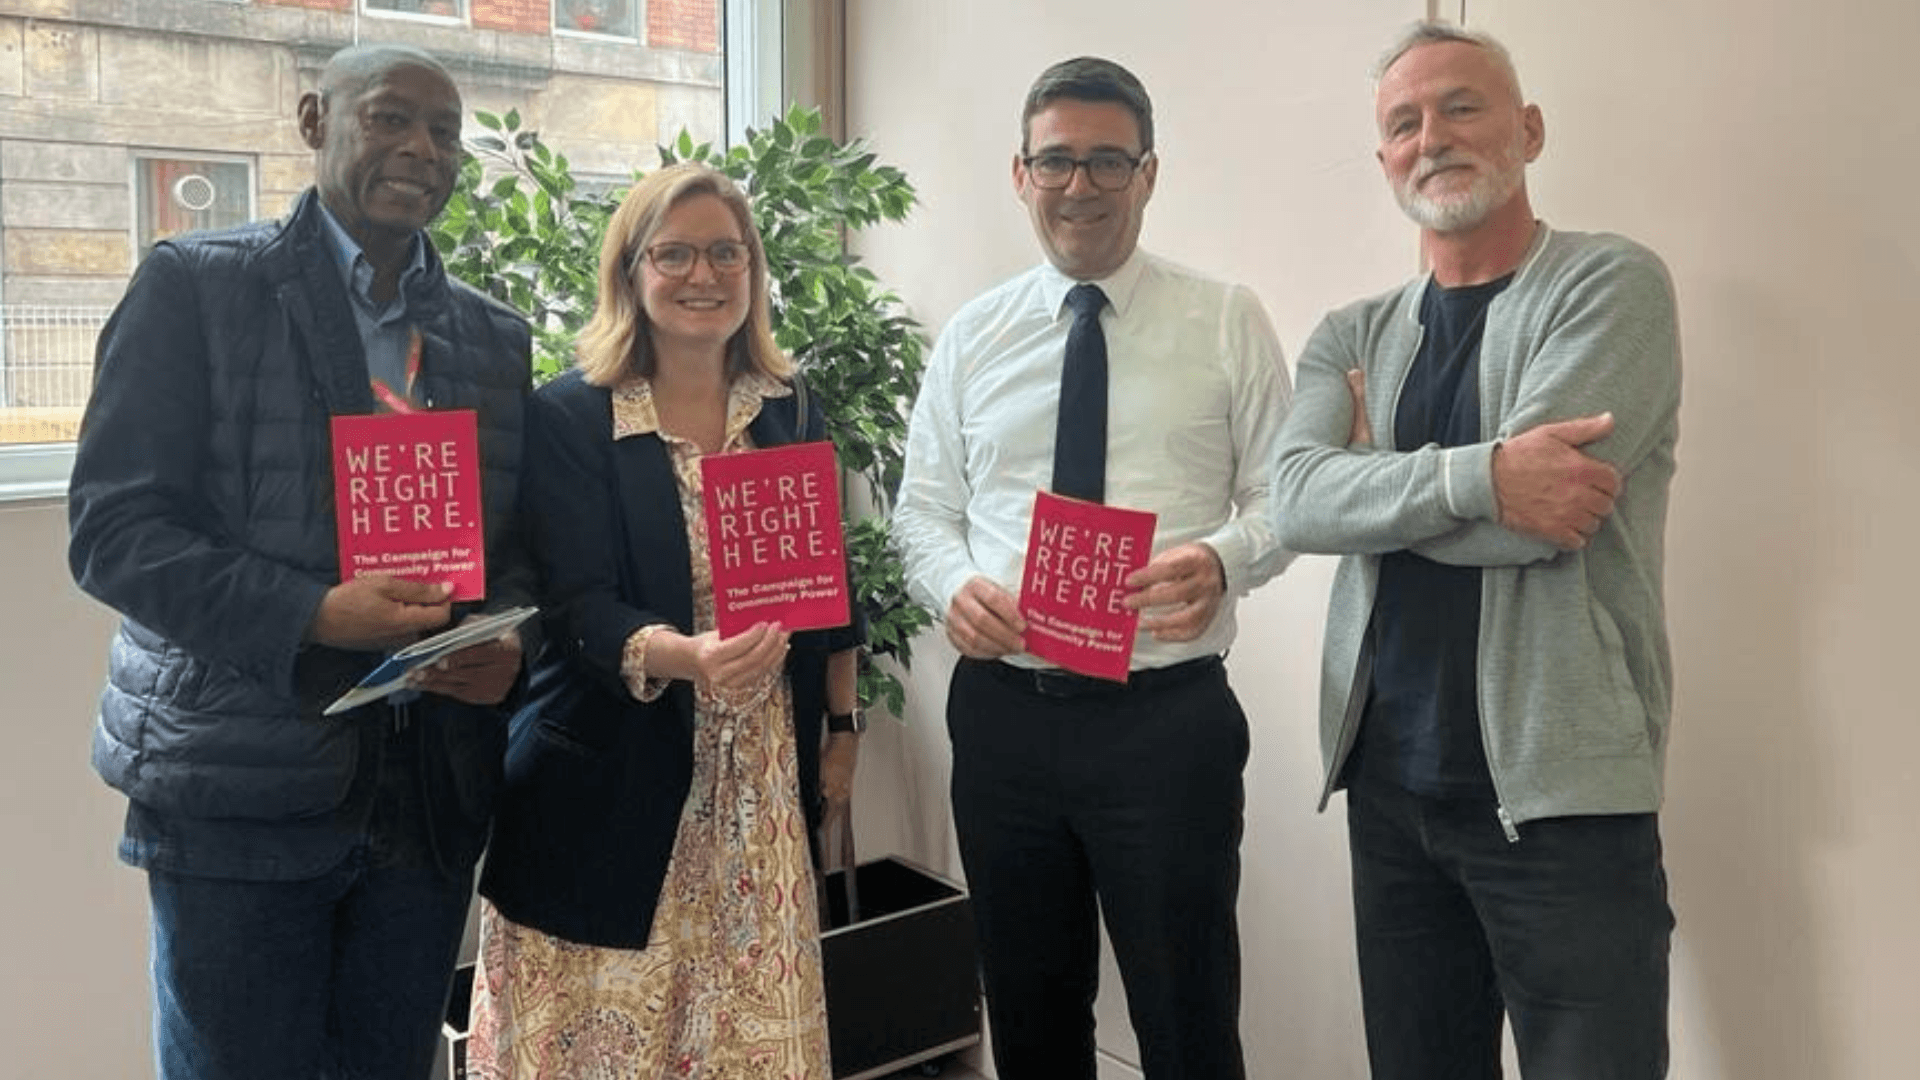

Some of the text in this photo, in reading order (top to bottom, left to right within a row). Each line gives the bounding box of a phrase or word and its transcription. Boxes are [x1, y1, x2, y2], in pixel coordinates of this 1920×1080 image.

[346, 441, 458, 474] WE'RE
[350, 471, 460, 504] RIGHT
[715, 472, 819, 511] WE'RE
[352, 501, 475, 534] HERE.
[721, 502, 821, 540] RIGHT
[353, 547, 471, 565] The Campaign for
[723, 531, 838, 569] HERE.
[1040, 518, 1134, 561] WE'RE
[434, 561, 475, 572] Power
[1036, 545, 1131, 586] RIGHT
[726, 575, 834, 598] The Campaign for
[727, 587, 839, 612] Community Power
[1031, 572, 1133, 617] HERE.
[1027, 608, 1124, 641] The Campaign for
[1087, 638, 1124, 653] Power
